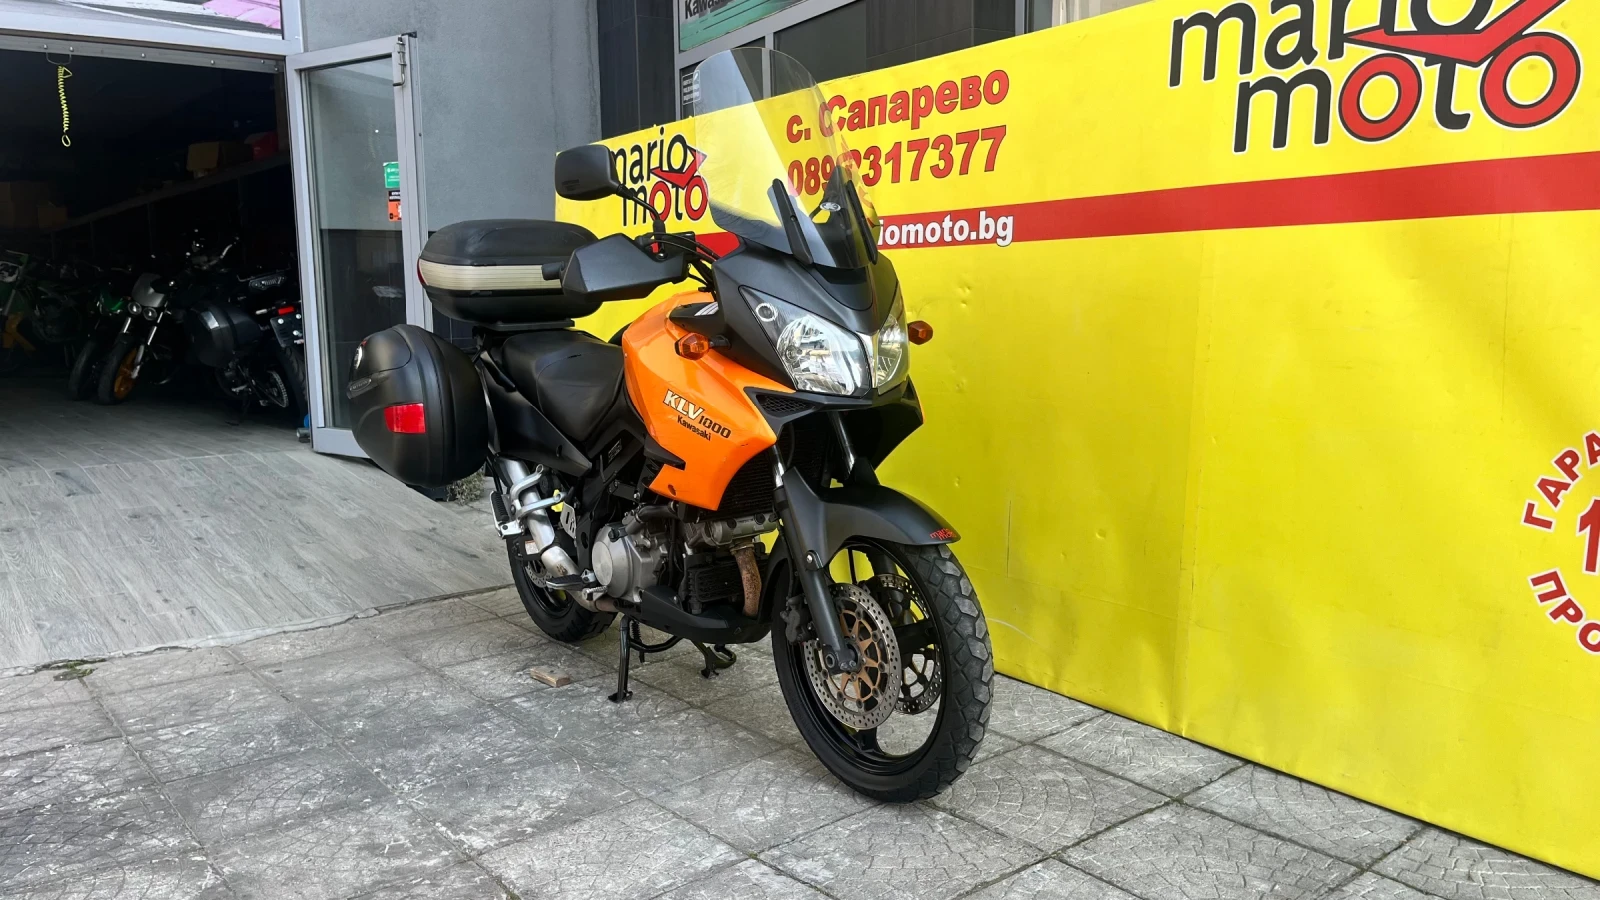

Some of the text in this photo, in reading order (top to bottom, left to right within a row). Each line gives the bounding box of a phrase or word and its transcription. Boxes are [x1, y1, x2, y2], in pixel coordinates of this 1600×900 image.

[818, 69, 1010, 138] Сапарево
[1234, 32, 1580, 152] moto
[622, 175, 709, 227] moto
[877, 210, 1014, 247] iomoto.bg
[677, 414, 711, 441] Kawasaki
